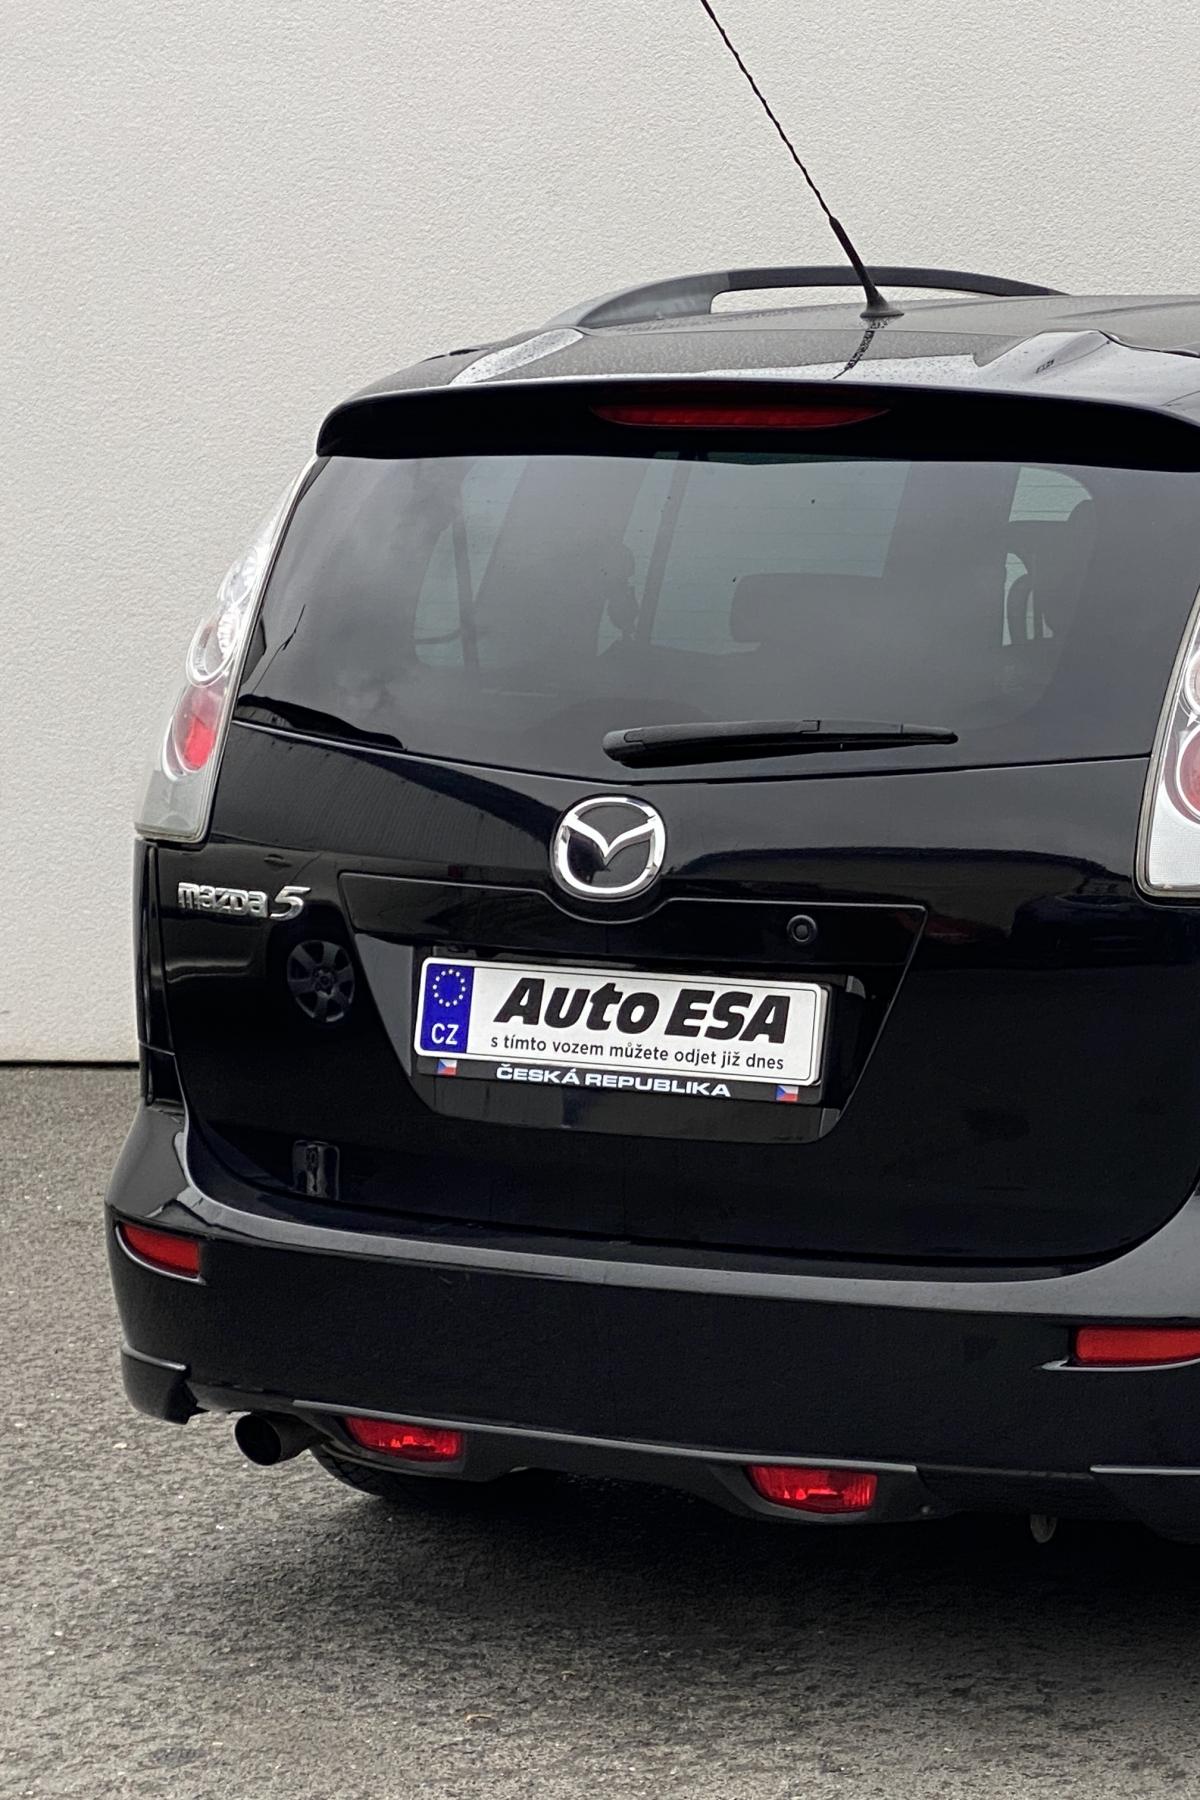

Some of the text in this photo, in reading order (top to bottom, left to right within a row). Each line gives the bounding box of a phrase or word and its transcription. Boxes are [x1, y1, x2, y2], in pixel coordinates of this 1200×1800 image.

[270, 885, 311, 921] 5
[493, 977, 791, 1045] Auto ESA
[431, 1022, 459, 1046] CZ
[490, 1034, 784, 1070] s tímto vozem můžete odjet již dnes
[496, 1063, 731, 1098] ČESKÁ REPUBLIKA
